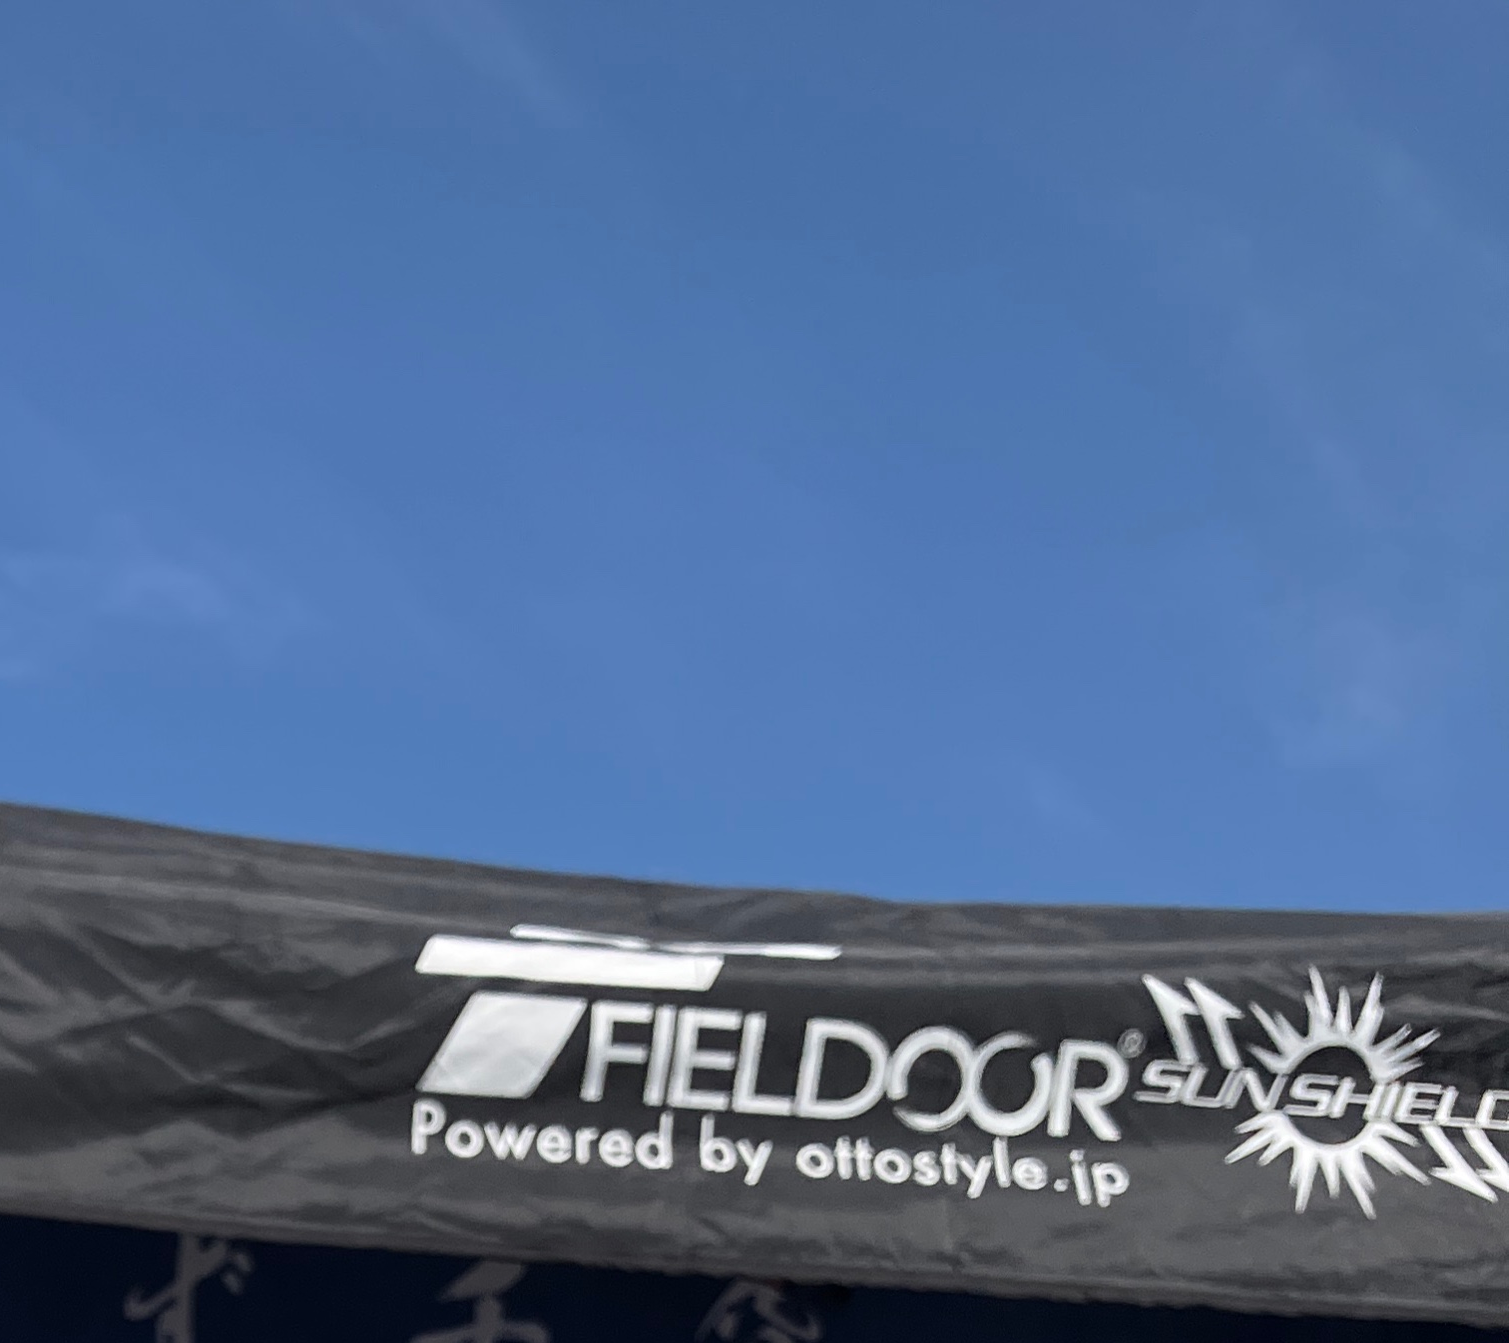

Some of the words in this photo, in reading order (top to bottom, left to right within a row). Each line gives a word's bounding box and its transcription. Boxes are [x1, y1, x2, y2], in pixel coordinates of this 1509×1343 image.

[580, 1001, 1129, 1142] FIELDOOR
[410, 1099, 674, 1171] Powered
[698, 1113, 774, 1187] by
[794, 1135, 1131, 1208] ottostyle.jp
